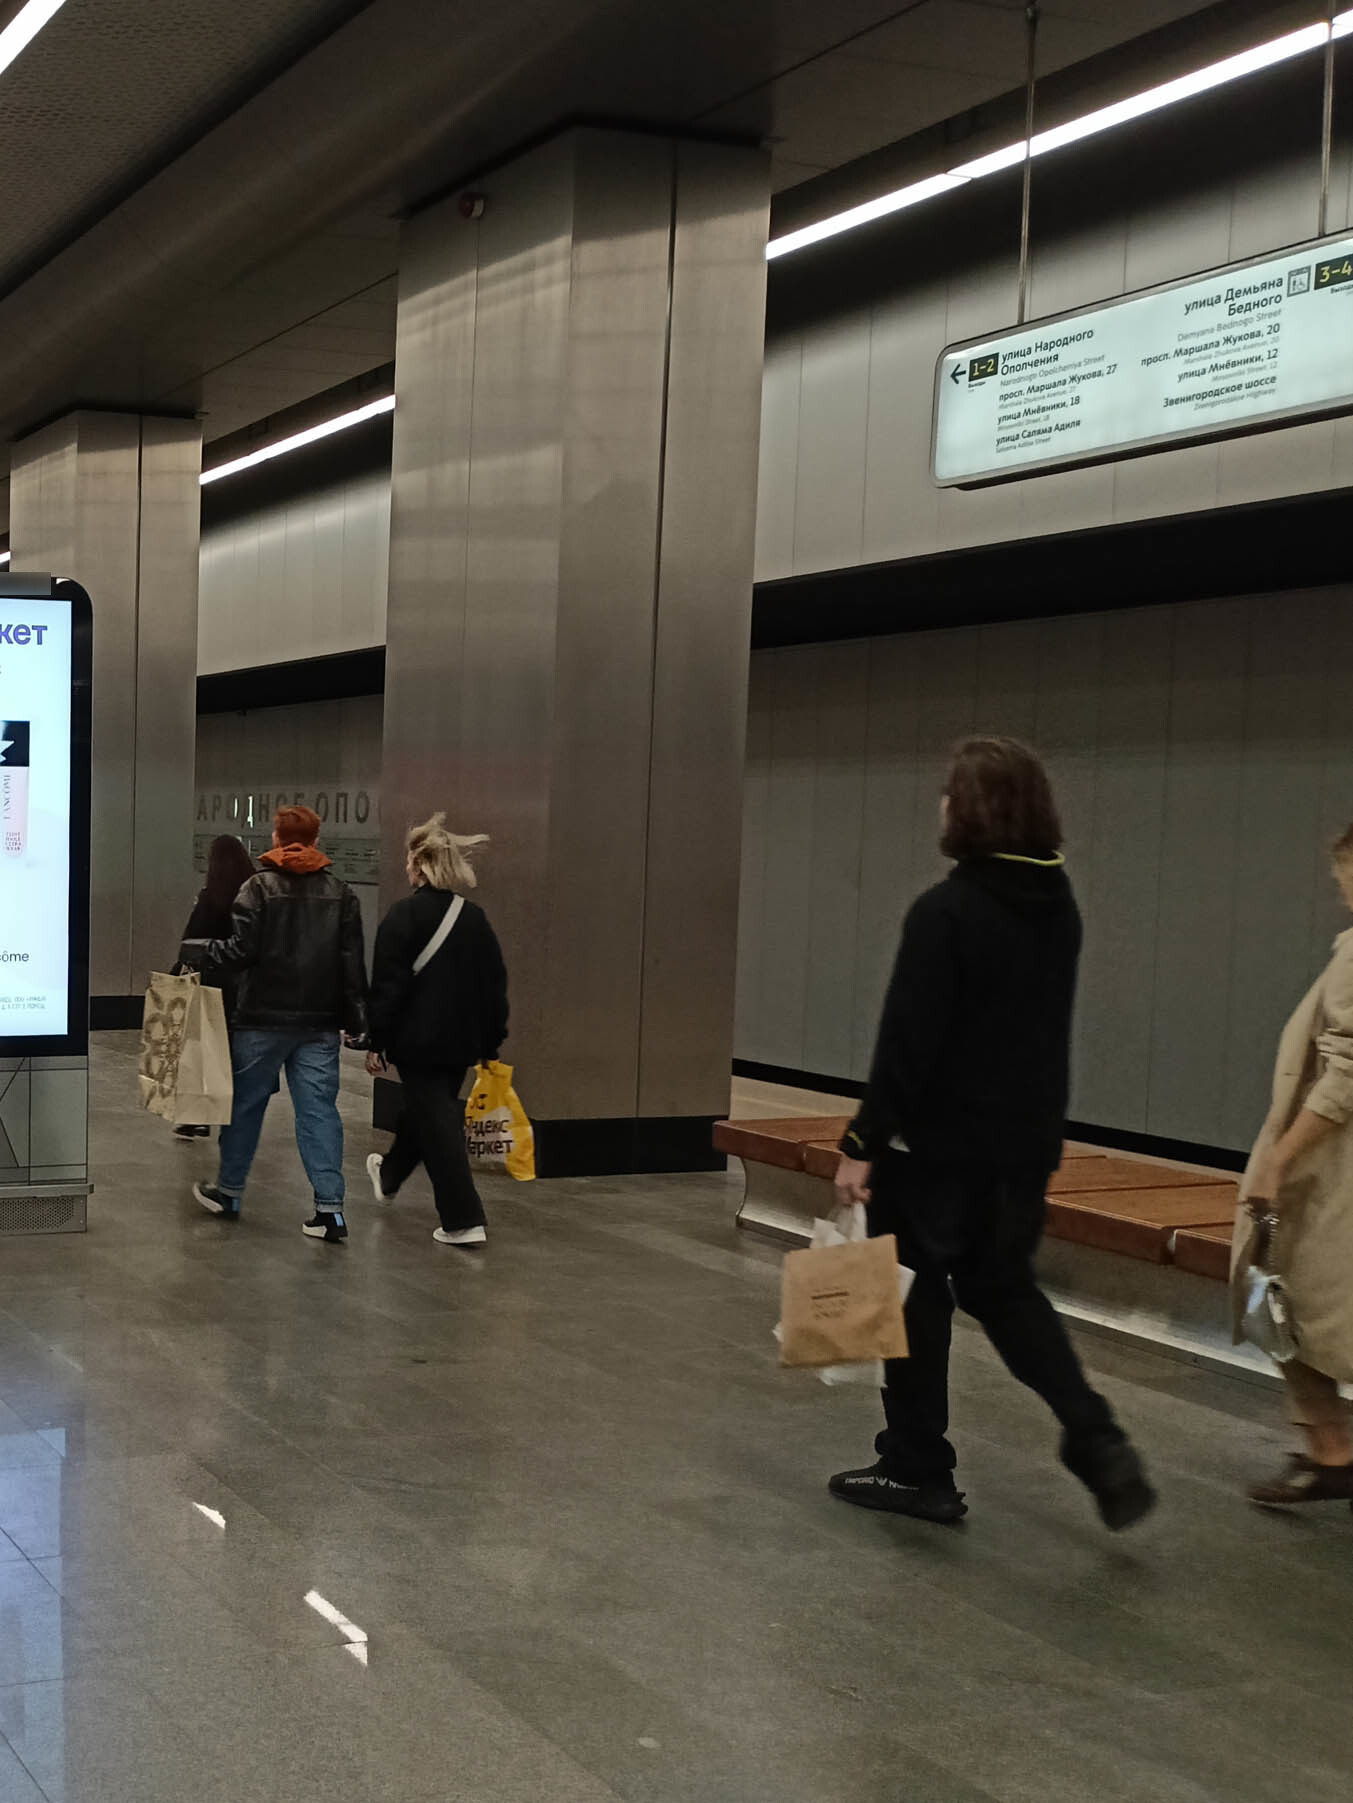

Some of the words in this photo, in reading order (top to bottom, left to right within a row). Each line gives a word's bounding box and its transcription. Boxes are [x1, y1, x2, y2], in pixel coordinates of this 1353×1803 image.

[1184, 294, 1221, 316] улица
[1224, 277, 1284, 304] Демьяна
[1228, 294, 1283, 317] Бедного
[1256, 308, 1282, 322] Street
[1001, 345, 1032, 364] улица
[1034, 329, 1094, 353] Народного
[1141, 353, 1171, 368] просп.
[1173, 339, 1220, 359] Маршала
[1222, 330, 1264, 349] Жукова,
[1266, 322, 1280, 335] 20
[1001, 353, 1059, 376] Ополчения
[1083, 354, 1106, 368] Street
[1177, 366, 1206, 383] улица
[1208, 354, 1264, 374] Мнёвники,
[1266, 348, 1279, 360] 12
[999, 389, 1025, 402] просп.
[1026, 377, 1067, 397] Маршала
[1068, 367, 1105, 386] Жукова,
[1106, 363, 1118, 375] 27
[1163, 383, 1243, 408] Звенигородское
[1244, 375, 1277, 390] шоссе
[997, 411, 1021, 425] улица
[1022, 399, 1069, 418] Мнёвники,
[1070, 395, 1080, 407] 18
[996, 432, 1020, 446] улица
[1021, 425, 1053, 440] Саляма
[1054, 418, 1081, 433] Адиля
